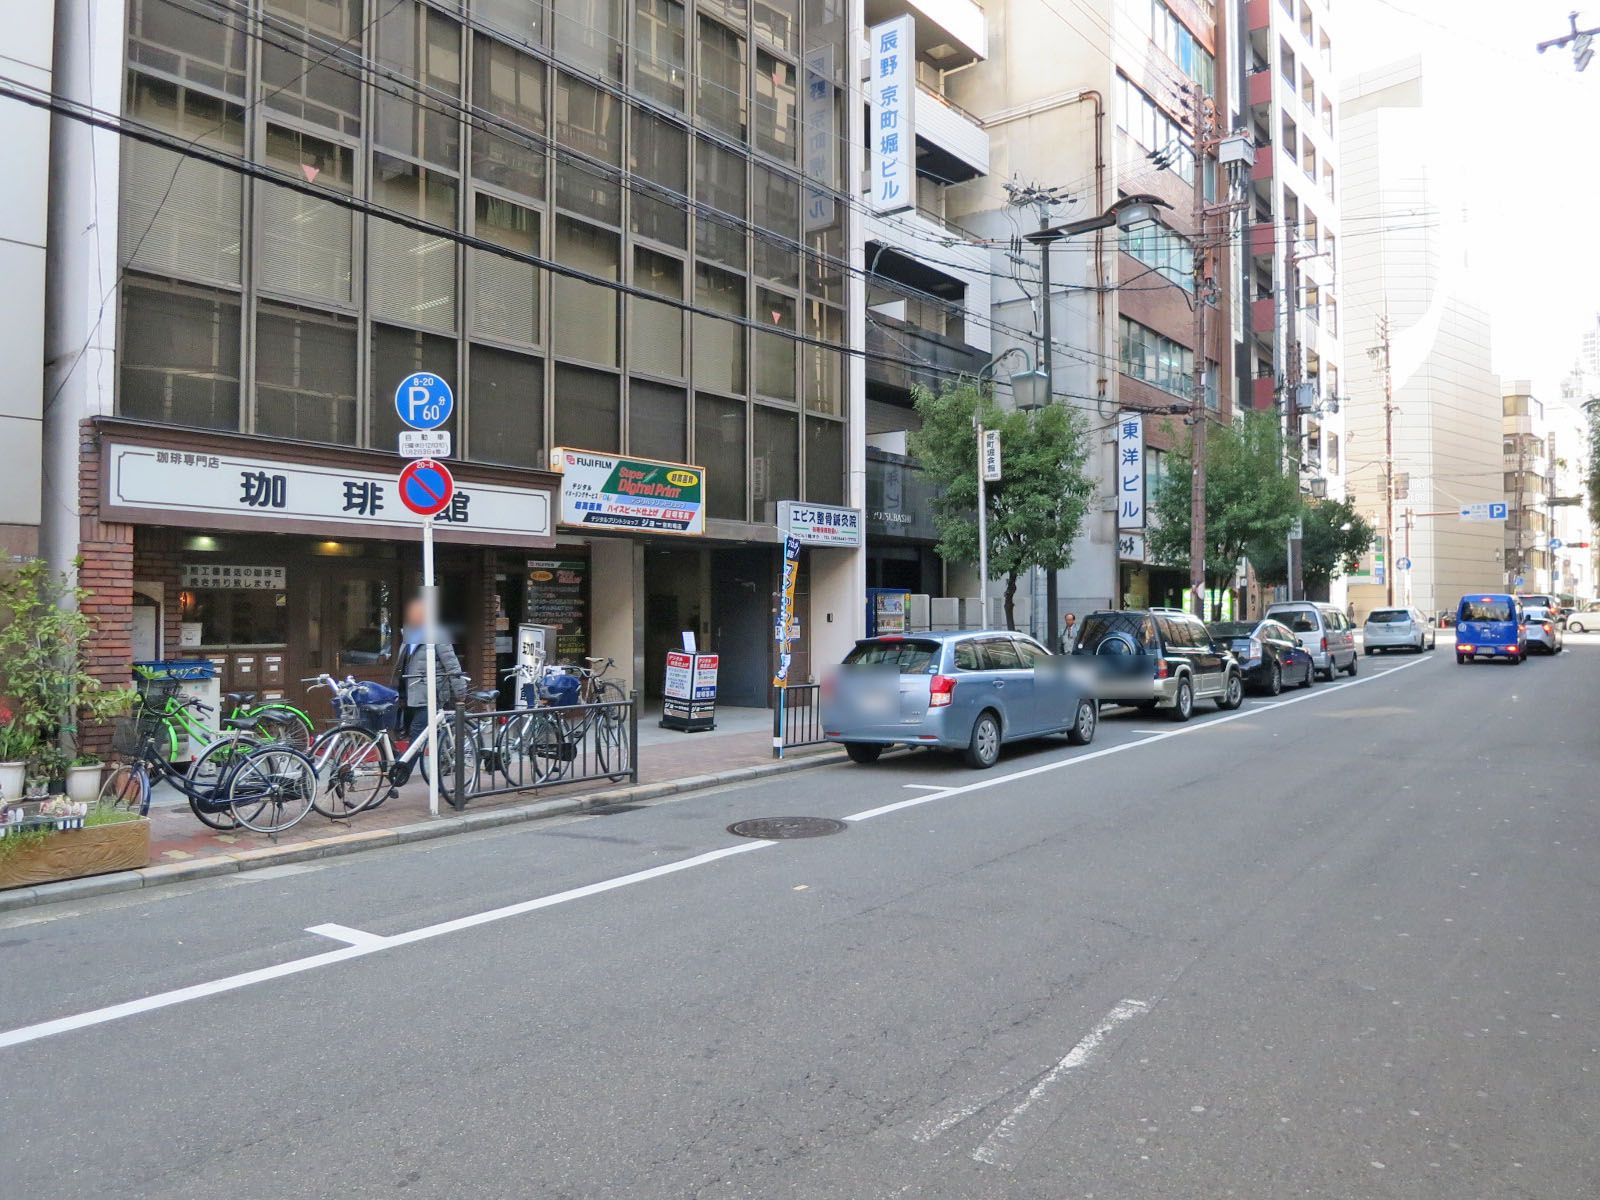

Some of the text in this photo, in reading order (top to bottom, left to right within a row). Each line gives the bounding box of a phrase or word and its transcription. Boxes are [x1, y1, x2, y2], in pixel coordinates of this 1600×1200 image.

[414, 378, 434, 386] 8-20
[408, 386, 430, 420] P
[156, 451, 220, 468] 珈琲専門店
[619, 467, 646, 479] Super
[1122, 422, 1139, 518] 東洋ビル
[618, 479, 682, 498] Digital Print
[607, 504, 658, 516] ハイスピード仕上げ
[1493, 505, 1503, 517] P
